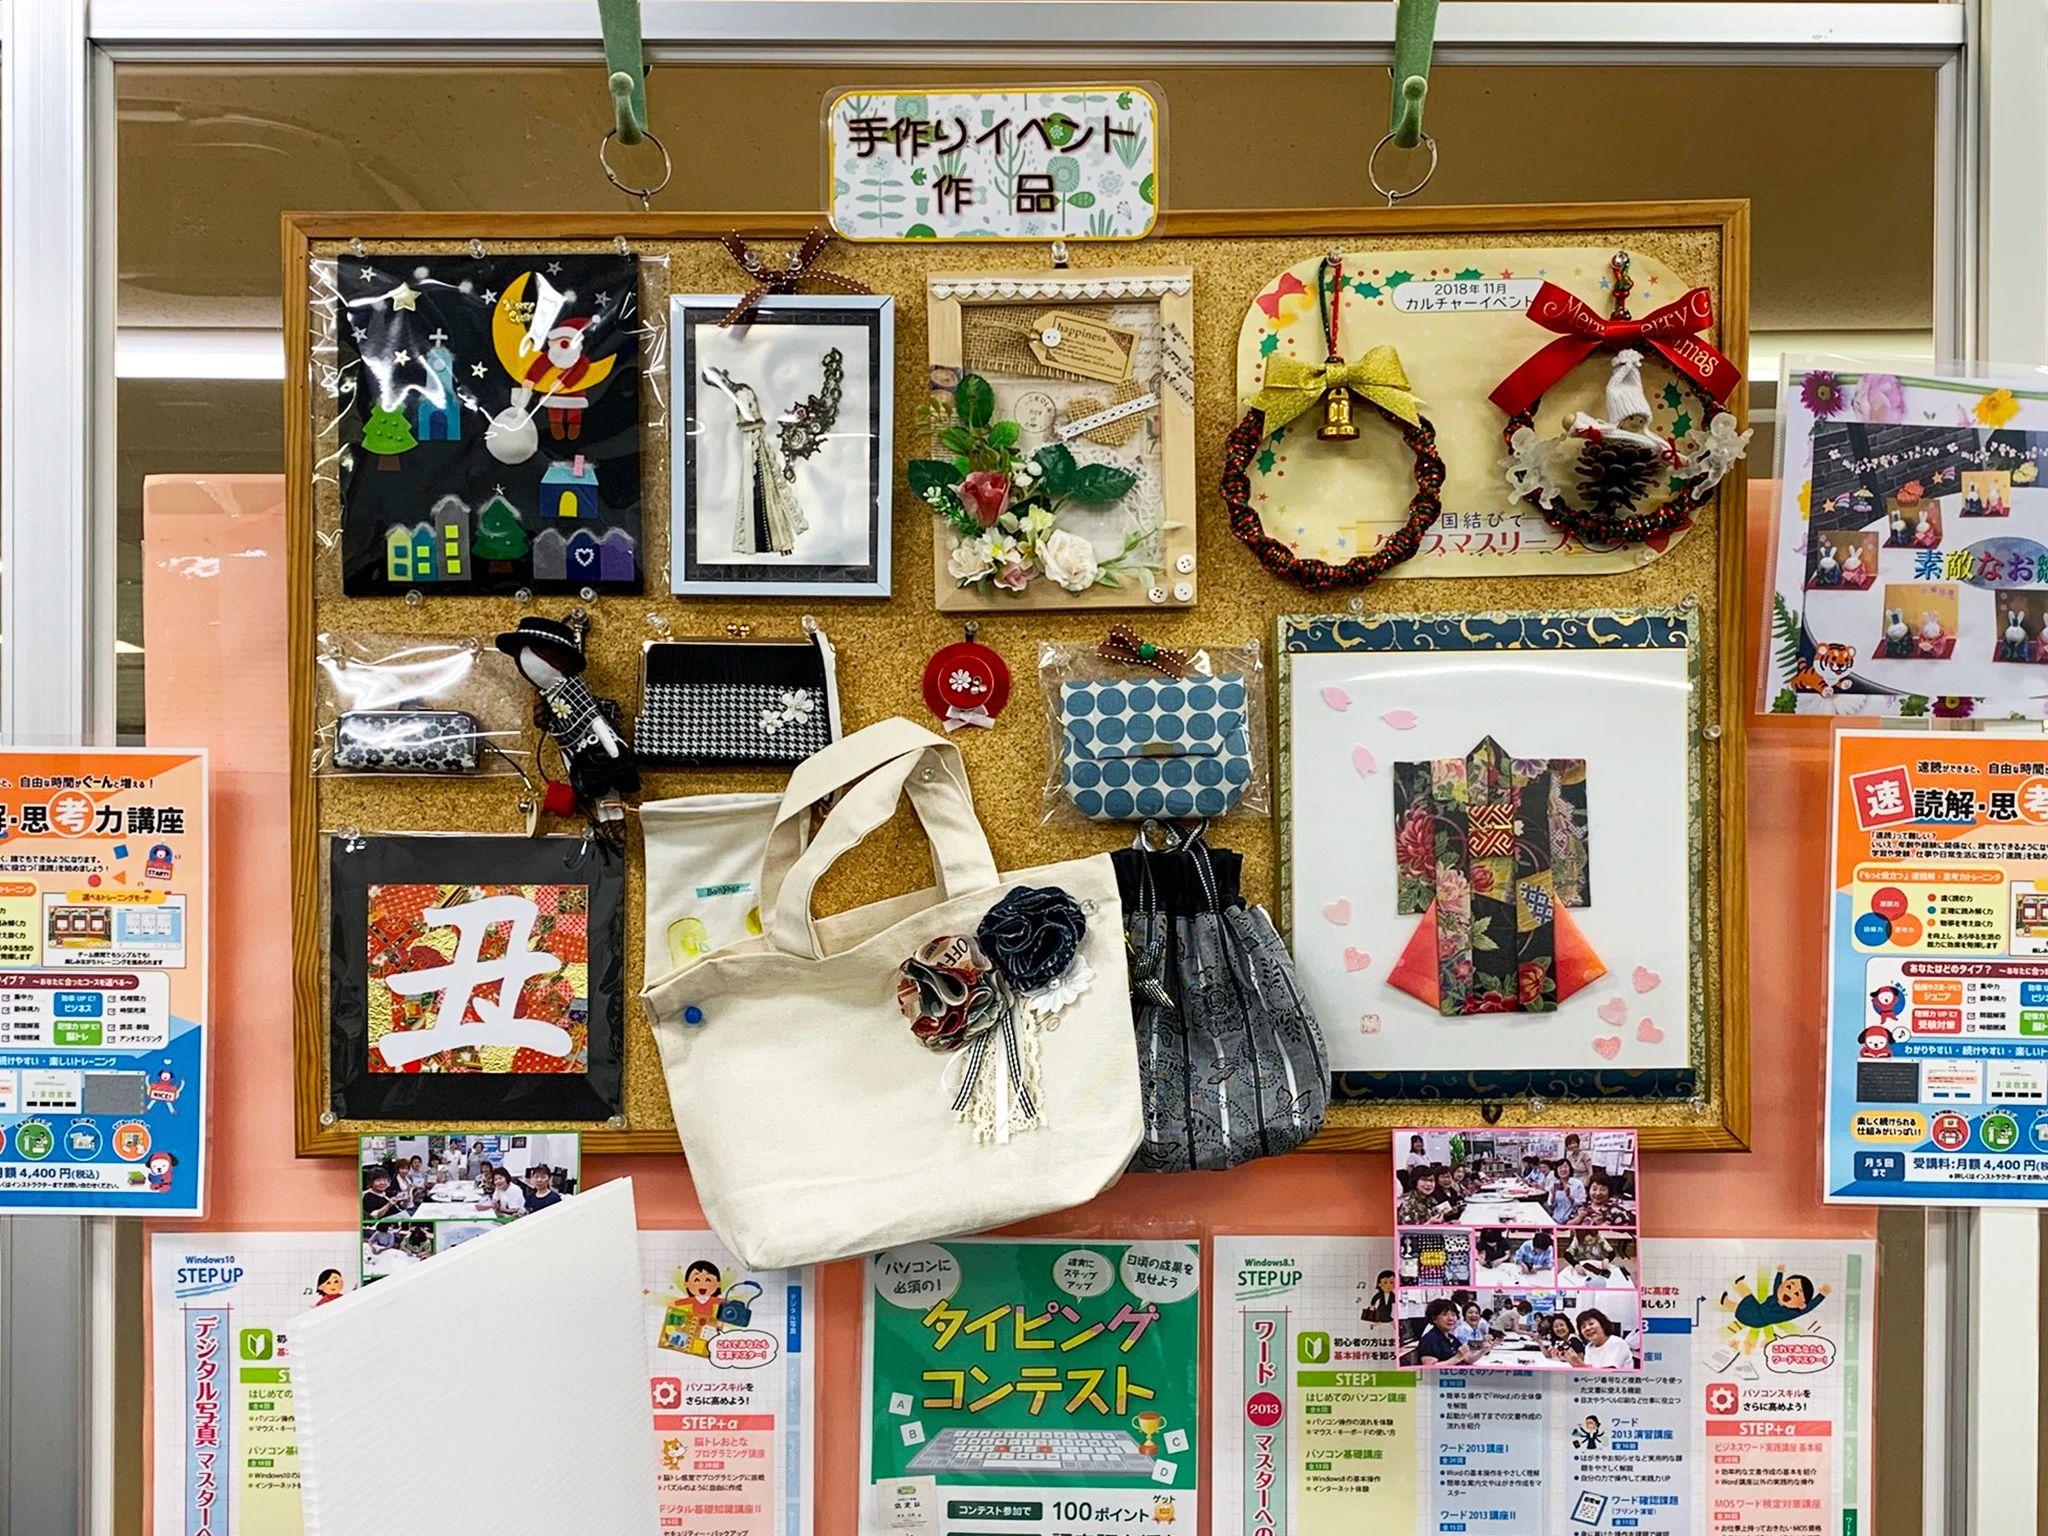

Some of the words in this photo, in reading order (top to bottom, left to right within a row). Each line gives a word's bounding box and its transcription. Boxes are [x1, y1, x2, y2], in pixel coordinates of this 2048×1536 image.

[850, 115, 1136, 157] 手作りイベント
[1434, 284, 1480, 295] 2018年
[1484, 283, 1507, 295] 11月
[1406, 296, 1533, 310] カルチャーイベント
[1542, 295, 1607, 337] Merr
[1640, 306, 1688, 337] erry
[1057, 322, 1107, 343] happiness
[1441, 512, 1525, 530] 国結びで
[1375, 531, 1573, 556] クスマスリース
[1918, 762, 1982, 774] 速読ができると、
[20, 776, 153, 789] 自由な時間がぐーんと増える！
[0, 799, 184, 834] ・思考力講座
[1909, 965, 1992, 975] あなたはどのタイプ？
[0, 976, 26, 984] イプ？
[378, 895, 574, 1067] 丑
[1983, 1159, 2020, 1171] 4,400
[19, 1168, 57, 1180] 4,400
[1872, 1168, 1887, 1178] まで
[185, 1255, 236, 1265] Windows10
[1126, 1253, 1195, 1276] 日頃の成果を
[1244, 1258, 1296, 1268] Windows8.1
[884, 1258, 952, 1275] パソコンに
[1063, 1268, 1099, 1279] ステップ
[893, 1278, 943, 1293] 必須の！
[1067, 1280, 1093, 1291] アップ
[1134, 1273, 1179, 1289] 見せよう
[921, 1298, 1160, 1353] タイピング
[1253, 1320, 1276, 1385] ワード
[194, 1316, 219, 1447] デジタル写真
[1335, 1373, 1378, 1387] STEP1
[685, 1382, 755, 1393] パソコンスキルを
[922, 1365, 1156, 1416] コンテスト
[1742, 1389, 1811, 1398] パソコンスキルを
[685, 1396, 750, 1406] さらに高めよう！
[1305, 1392, 1408, 1404] はじめてのパソコン講座
[896, 1400, 905, 1410] A
[1249, 1404, 1280, 1415] 2013
[1743, 1402, 1807, 1412] さらに高めよう！
[1611, 1418, 1639, 1427] ワード
[909, 1429, 918, 1439] B
[1172, 1437, 1181, 1447] C
[248, 1446, 298, 1456] パソコン基
[1159, 1467, 1169, 1478] D
[1152, 1493, 1176, 1504] ゲット
[958, 1503, 1032, 1517] コンテスト参加で
